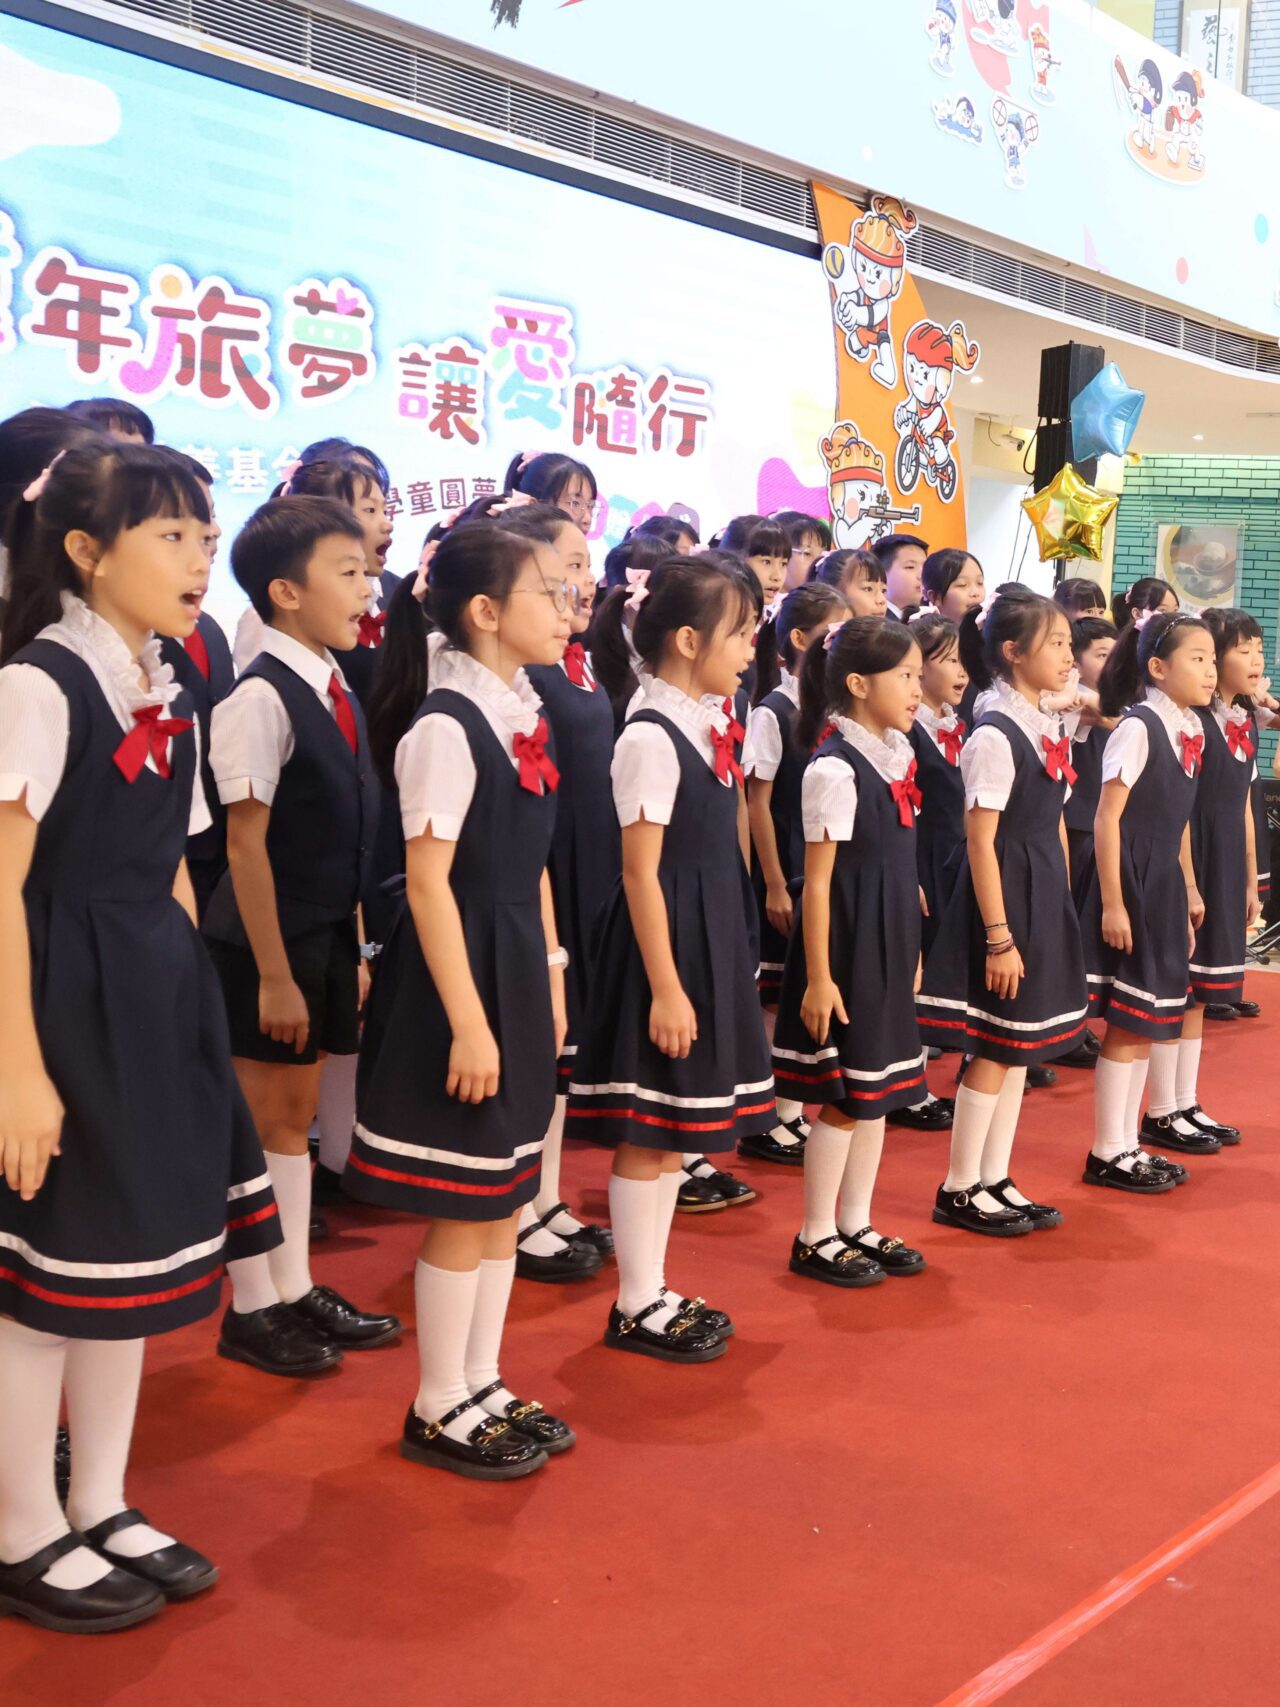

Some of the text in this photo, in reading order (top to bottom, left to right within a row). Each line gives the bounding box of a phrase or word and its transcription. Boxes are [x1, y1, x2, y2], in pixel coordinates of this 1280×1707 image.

[0, 224, 708, 458] 年旅夢 讓愛隨行
